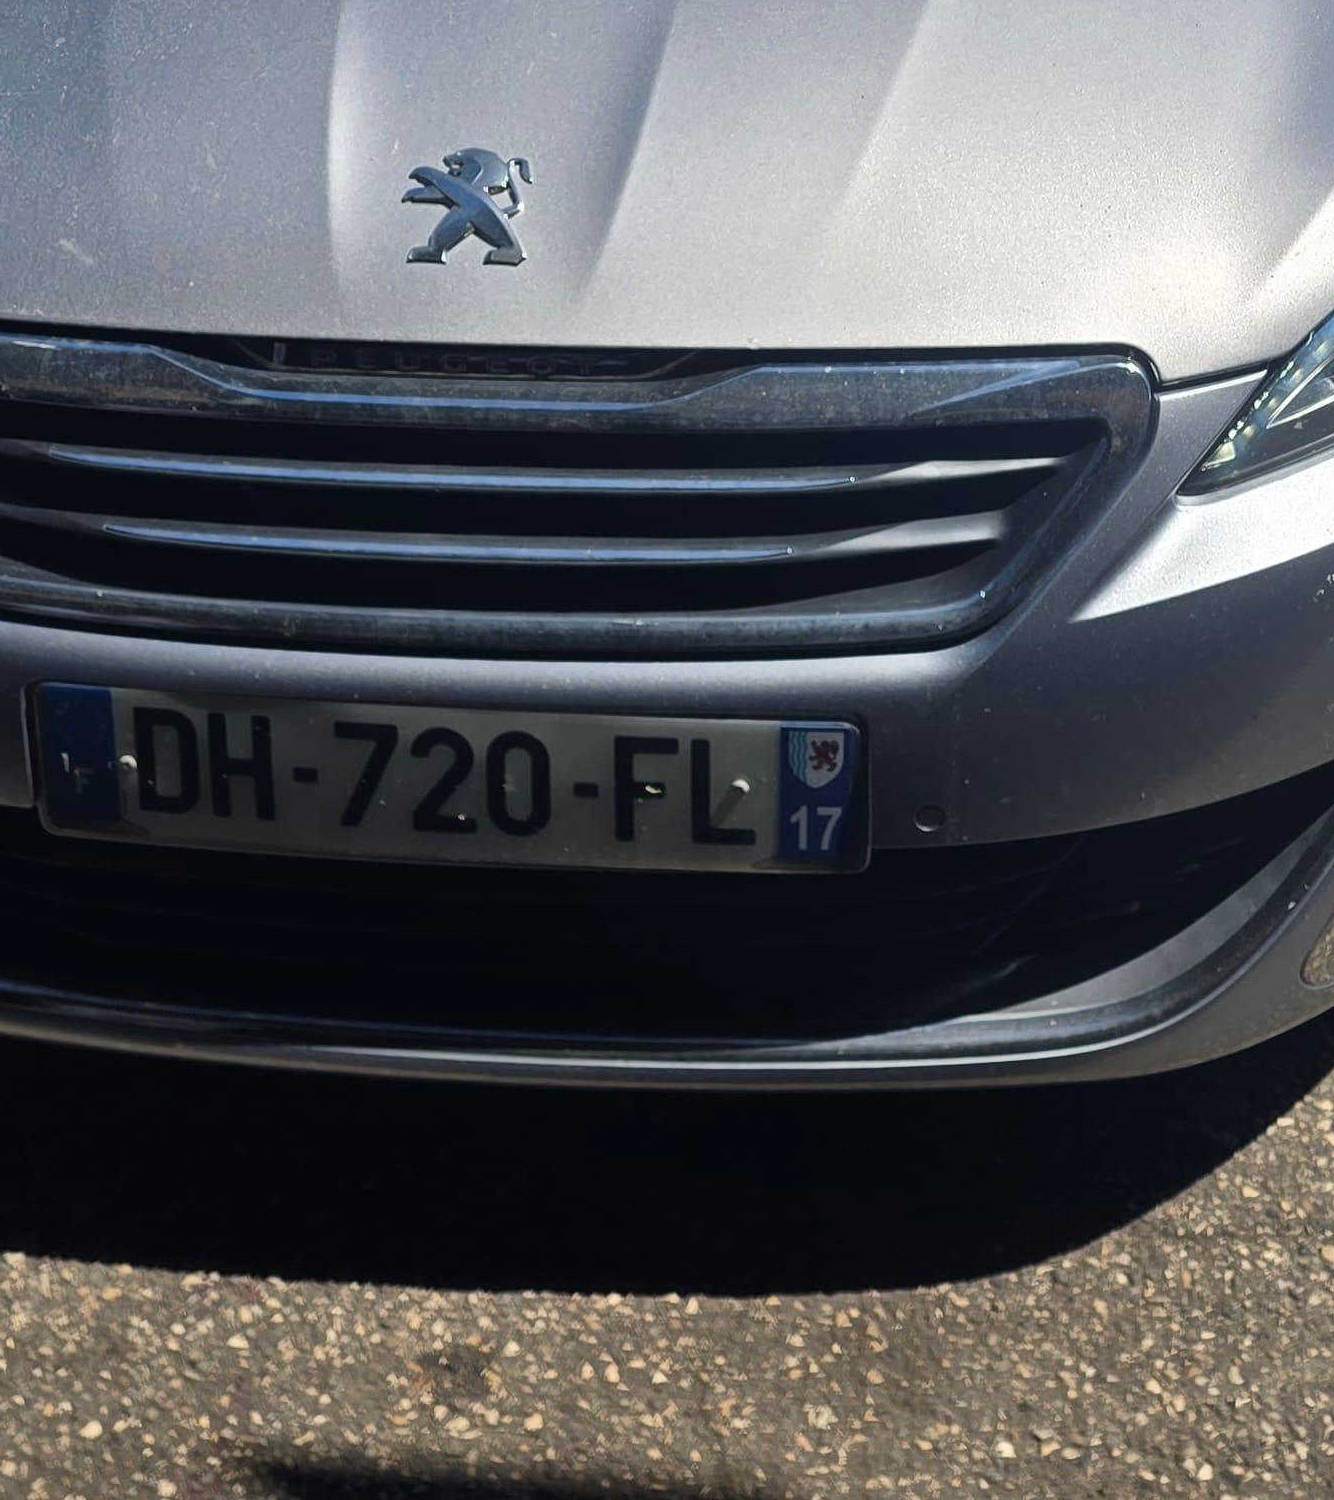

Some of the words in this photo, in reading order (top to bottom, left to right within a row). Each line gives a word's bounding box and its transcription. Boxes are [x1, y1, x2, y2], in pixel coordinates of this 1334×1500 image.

[310, 348, 602, 376] PEUGEOT
[132, 706, 757, 846] DH-720-FL
[788, 805, 844, 852] 17
